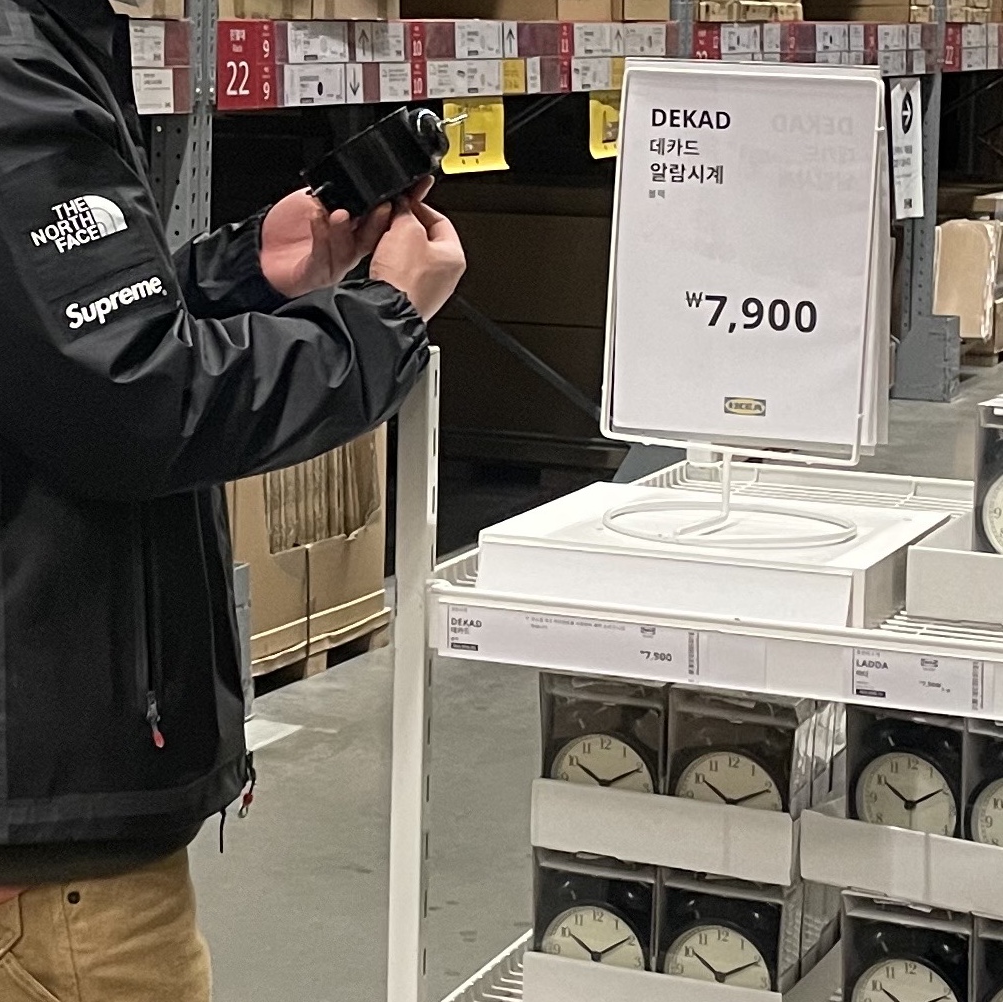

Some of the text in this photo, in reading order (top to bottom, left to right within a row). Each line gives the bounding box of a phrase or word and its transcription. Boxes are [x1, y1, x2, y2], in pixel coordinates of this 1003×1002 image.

[262, 39, 270, 58] 9
[412, 40, 423, 57] 10
[226, 61, 250, 96] 22
[262, 81, 271, 101] 9
[413, 77, 423, 94] 10
[651, 108, 731, 130] DEKAD
[649, 138, 700, 156] 데카드
[650, 162, 724, 184] 알람시계
[51, 196, 90, 220] THE
[30, 210, 98, 247] NORTH
[54, 224, 101, 253] FACE
[993, 506, 1003, 520] 9
[450, 617, 483, 628] DEKAD
[856, 659, 889, 670] LADDA
[582, 742, 592, 754] 11
[600, 738, 612, 750] 12
[622, 746, 627, 758] 1
[568, 755, 579, 767] 10
[709, 760, 719, 772] 11
[728, 755, 741, 768] 12
[890, 761, 899, 774] 11
[907, 757, 920, 771] 12
[750, 764, 756, 777] 1
[694, 772, 705, 785] 10
[876, 773, 887, 786] 10
[868, 793, 878, 804] 9
[984, 814, 993, 828] 9
[574, 914, 584, 926] 11
[592, 910, 604, 922] 12
[614, 918, 619, 930] 1
[560, 926, 571, 938] 10
[717, 929, 730, 942] 12
[699, 933, 708, 945] 11
[740, 938, 745, 950] 1
[684, 945, 695, 958] 10
[885, 966, 896, 980] 11
[903, 962, 918, 975] 12
[928, 970, 933, 983] 1
[871, 979, 883, 992] 10
